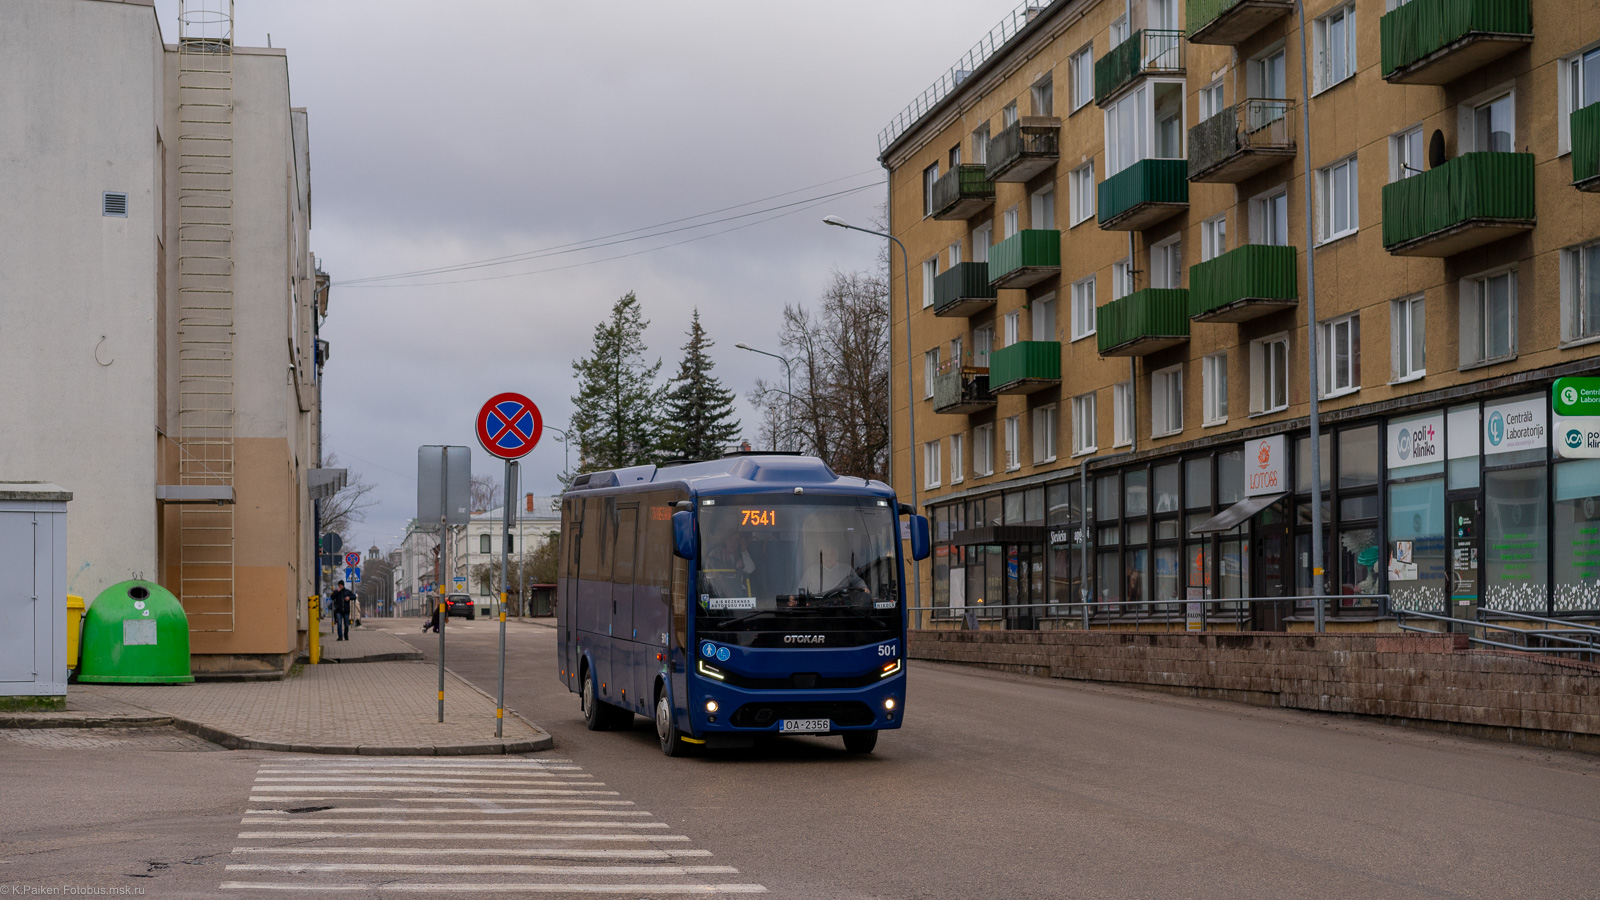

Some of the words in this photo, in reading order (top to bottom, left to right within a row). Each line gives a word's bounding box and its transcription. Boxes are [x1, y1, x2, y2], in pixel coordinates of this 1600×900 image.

[1506, 411, 1533, 425] Centrālā
[1506, 424, 1544, 439] Laboratorija
[1587, 432, 1600, 441] po
[1250, 470, 1277, 489] LOTOSS
[741, 510, 776, 526] 7541
[783, 634, 825, 644] OTOKAR
[878, 645, 896, 656] 501
[786, 720, 828, 730] OA-2356
